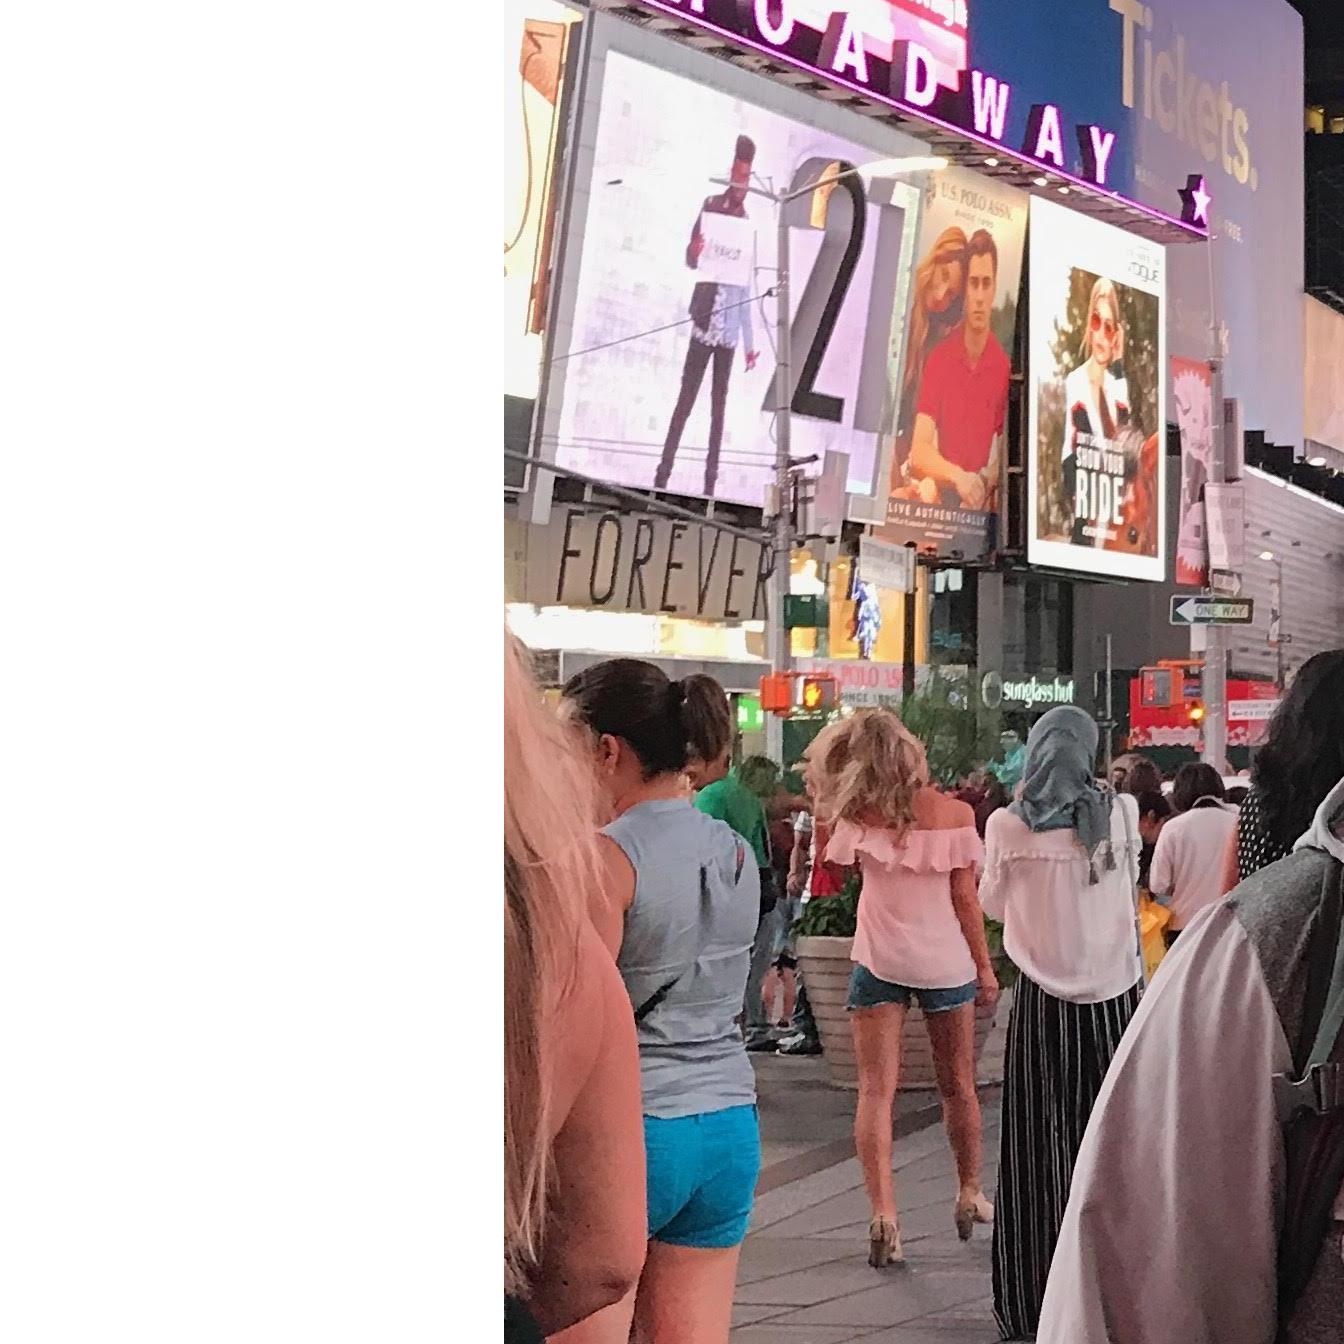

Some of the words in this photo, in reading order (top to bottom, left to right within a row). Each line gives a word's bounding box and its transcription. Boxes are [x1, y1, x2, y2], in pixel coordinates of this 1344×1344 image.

[888, 501, 911, 517] LIVE
[1075, 468, 1125, 526] RIDE
[556, 509, 776, 620] FOREVER
[1195, 605, 1219, 617] ONE
[1221, 606, 1245, 617] WAY
[1003, 675, 1054, 709] sunglass
[1054, 676, 1075, 705] hut
